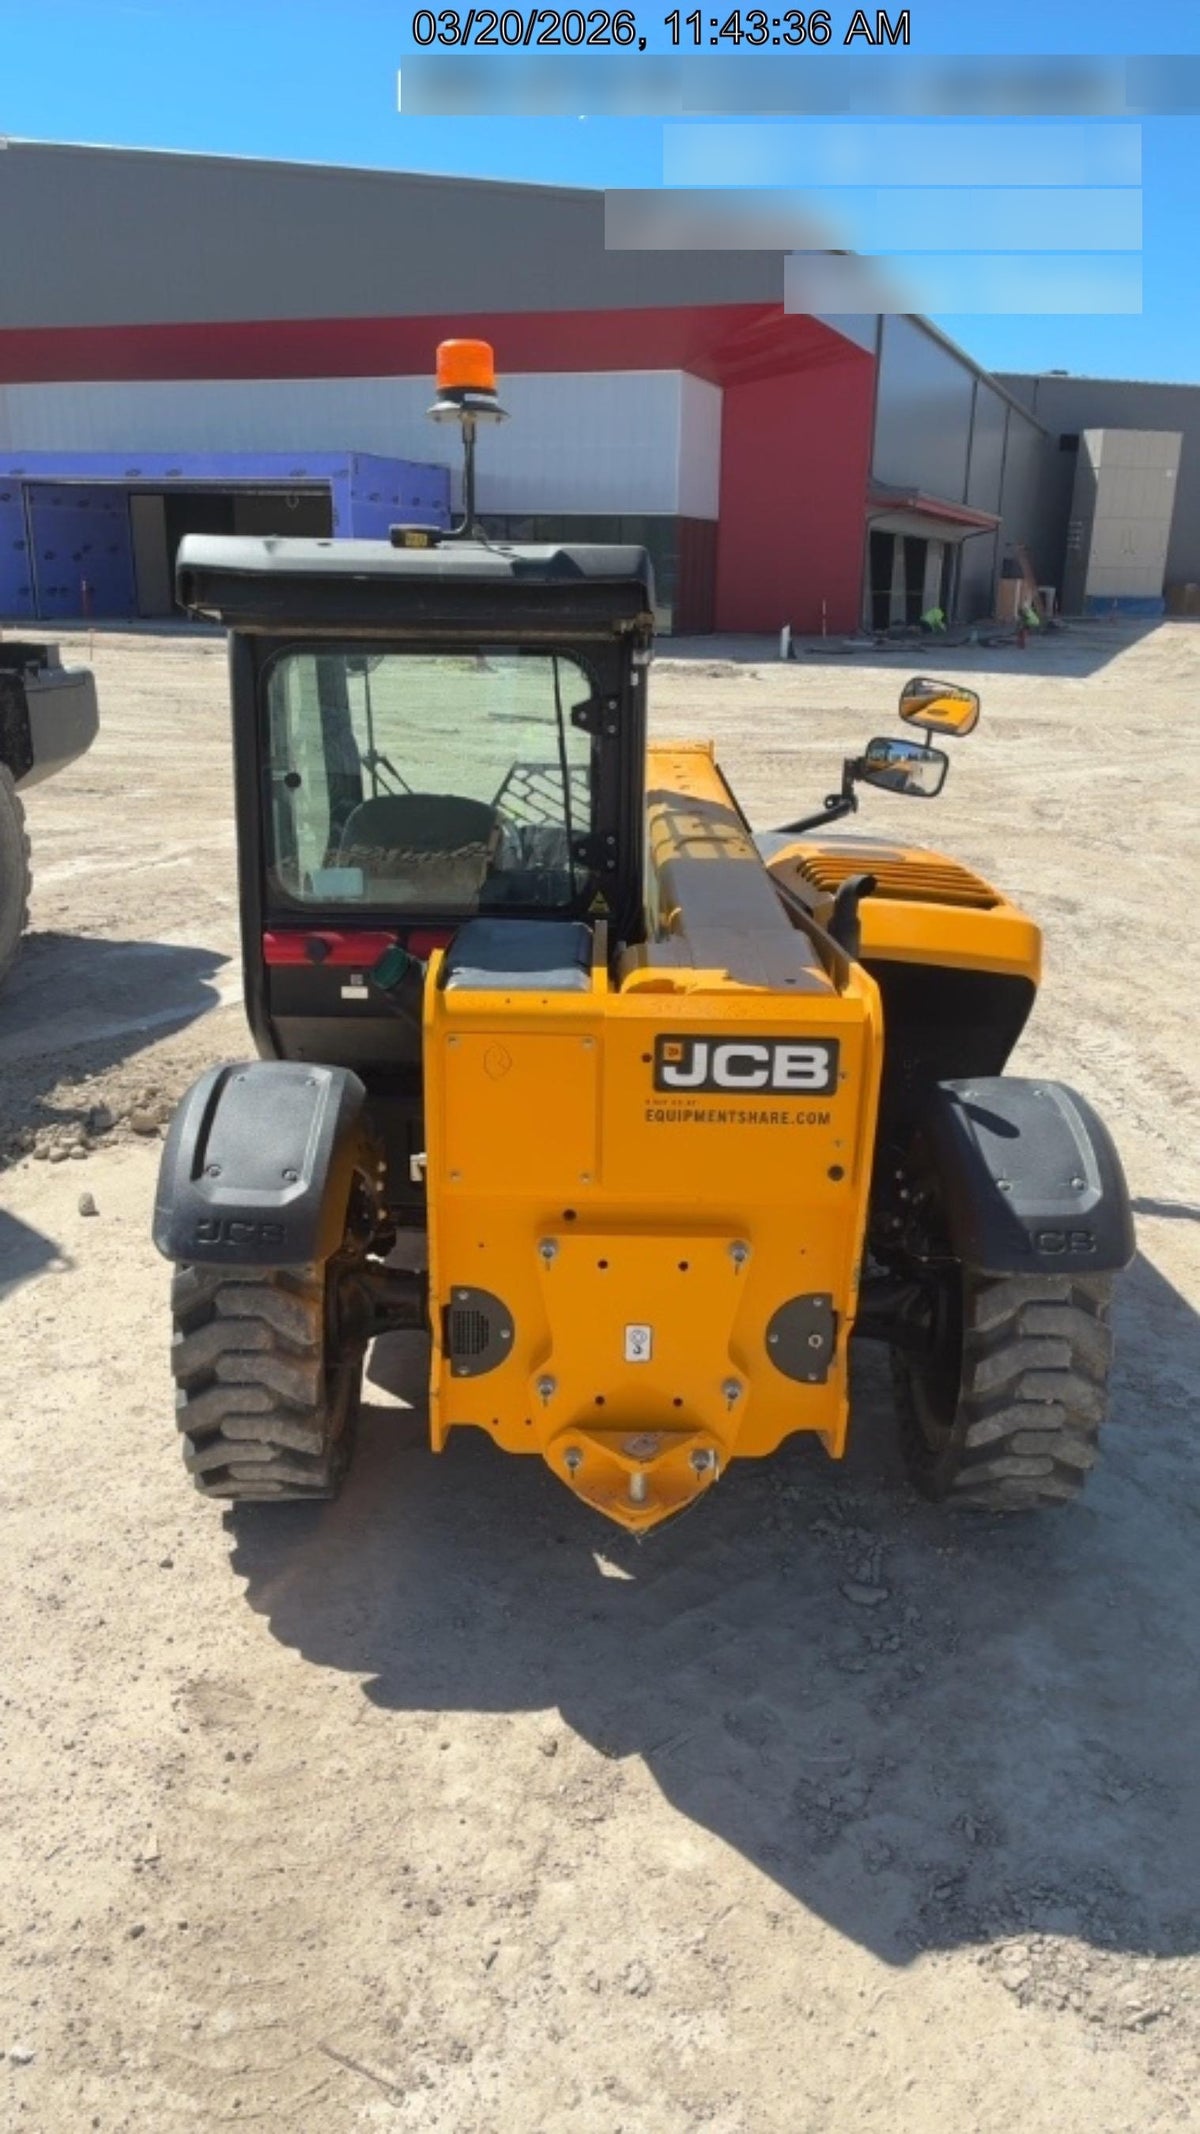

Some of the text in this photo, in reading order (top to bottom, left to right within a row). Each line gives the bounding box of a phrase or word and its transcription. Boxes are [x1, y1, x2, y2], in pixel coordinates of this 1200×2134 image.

[662, 1042, 829, 1089] JCB
[645, 1109, 831, 1125] EQUIPMENTSHARE.COM
[197, 1217, 288, 1247] JCB
